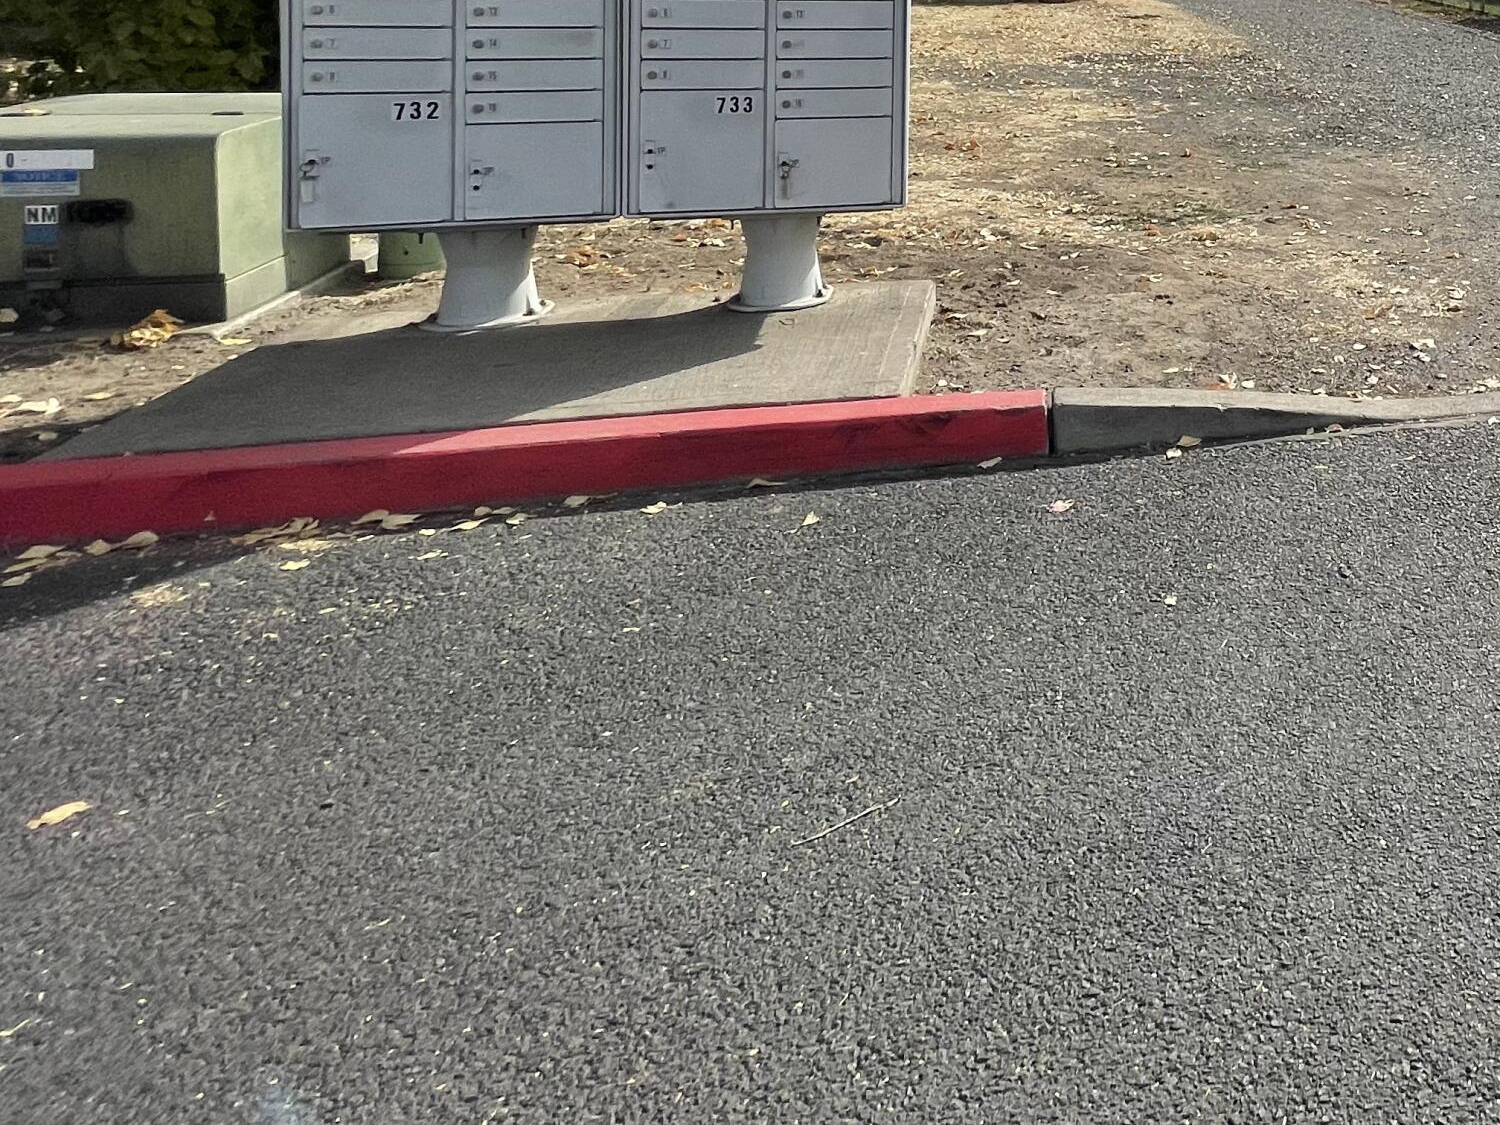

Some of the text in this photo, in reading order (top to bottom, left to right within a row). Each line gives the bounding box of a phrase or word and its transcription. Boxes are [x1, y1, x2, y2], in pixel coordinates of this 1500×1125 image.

[393, 102, 439, 120] 732
[716, 97, 753, 114] 733
[26, 207, 57, 223] NM
